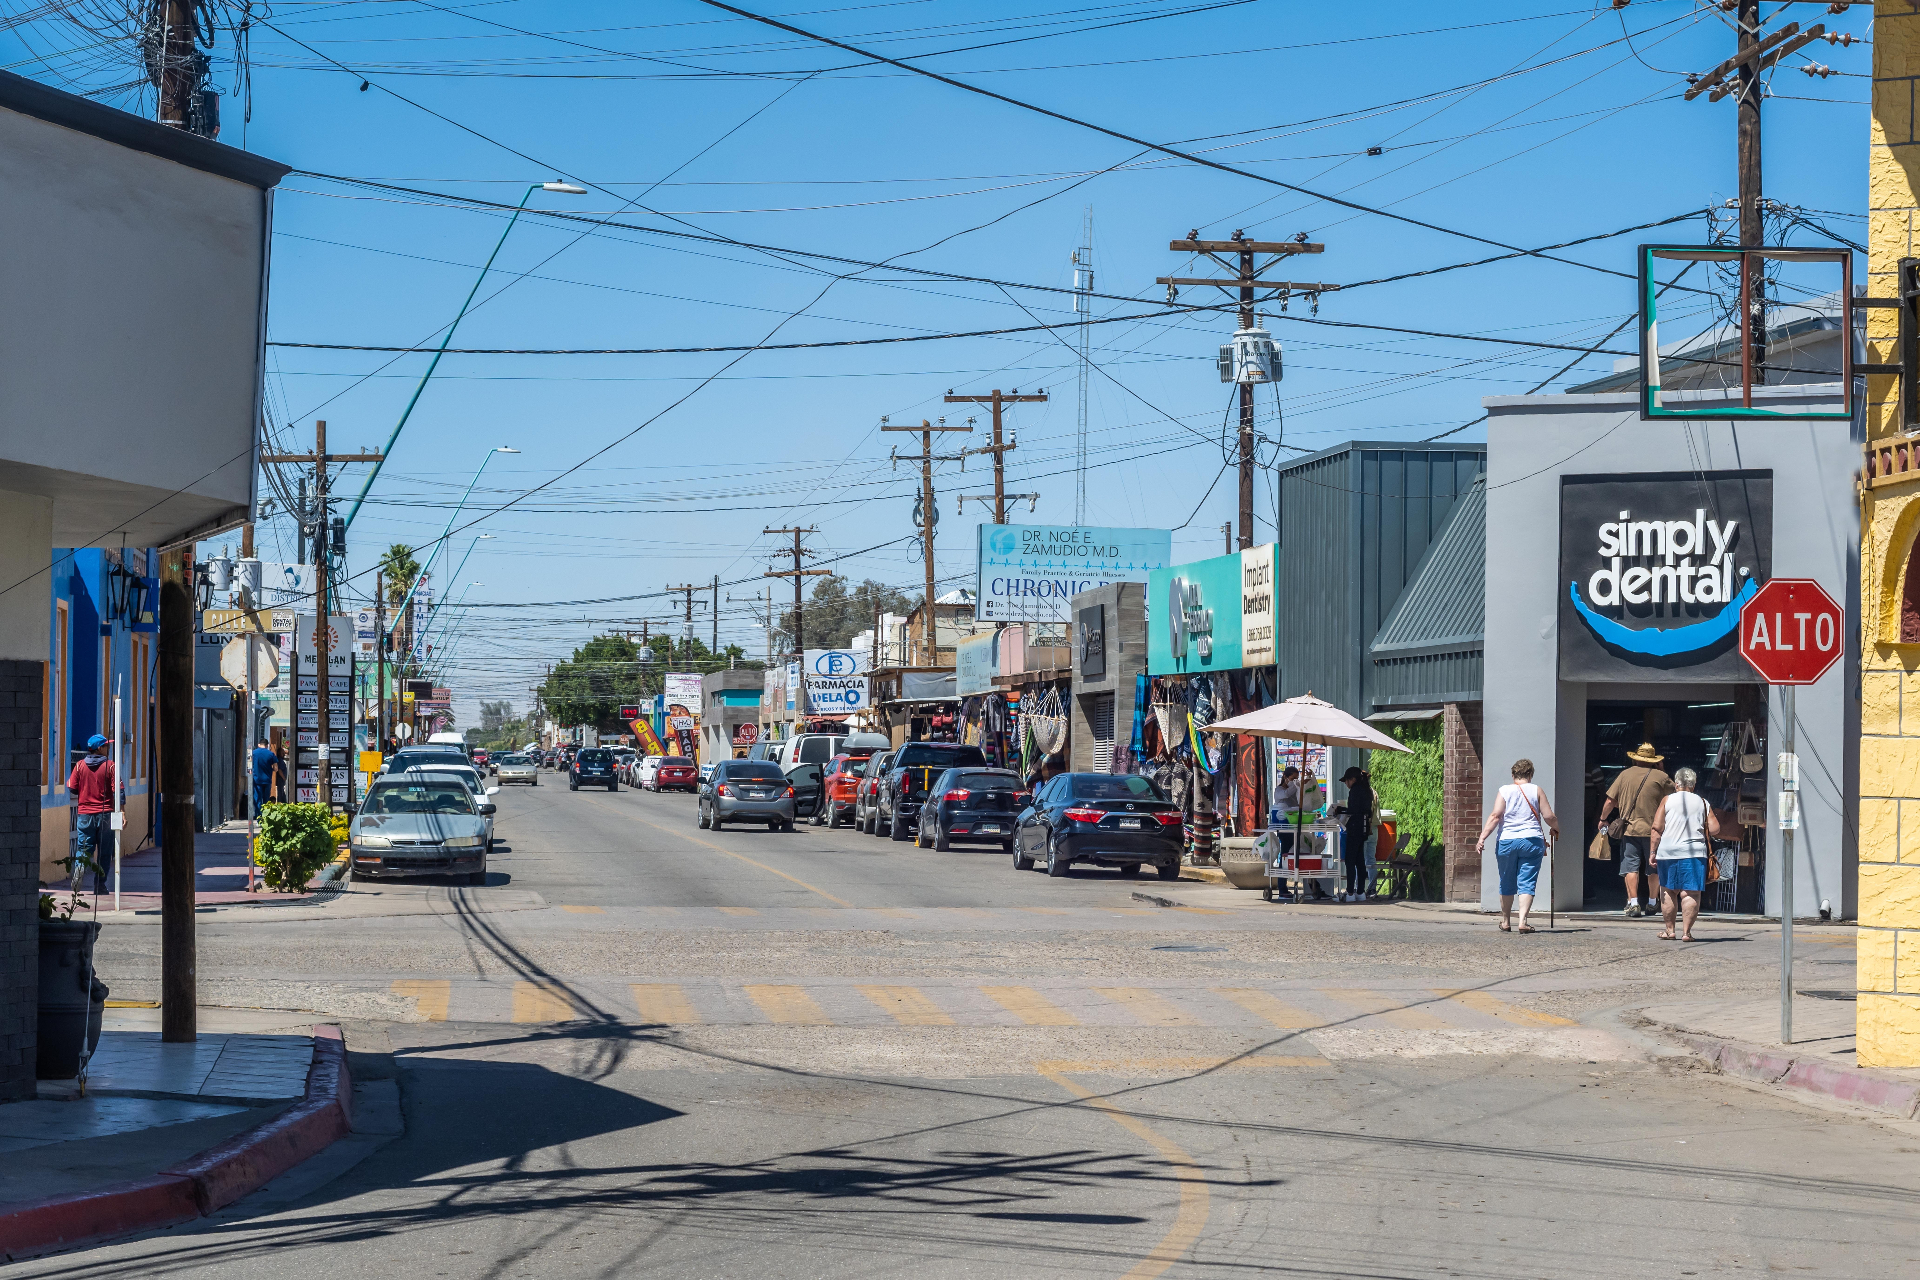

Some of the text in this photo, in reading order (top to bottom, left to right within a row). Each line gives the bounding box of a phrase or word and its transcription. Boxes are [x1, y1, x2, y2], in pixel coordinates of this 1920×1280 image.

[1022, 529, 1095, 544] DR. NOÉ E.
[1598, 508, 1739, 567] simply
[1022, 543, 1122, 558] ZAMUDIO M.D.
[1021, 568, 1041, 577] Family
[1043, 569, 1067, 577] Practice
[1244, 559, 1269, 592] Implant
[1588, 552, 1736, 606] dental
[1243, 592, 1271, 615] Dentistry
[211, 613, 246, 629] CALLE
[1749, 612, 1835, 651] ALTO
[808, 680, 865, 690] FARMACIA
[741, 727, 756, 737] ALTO
